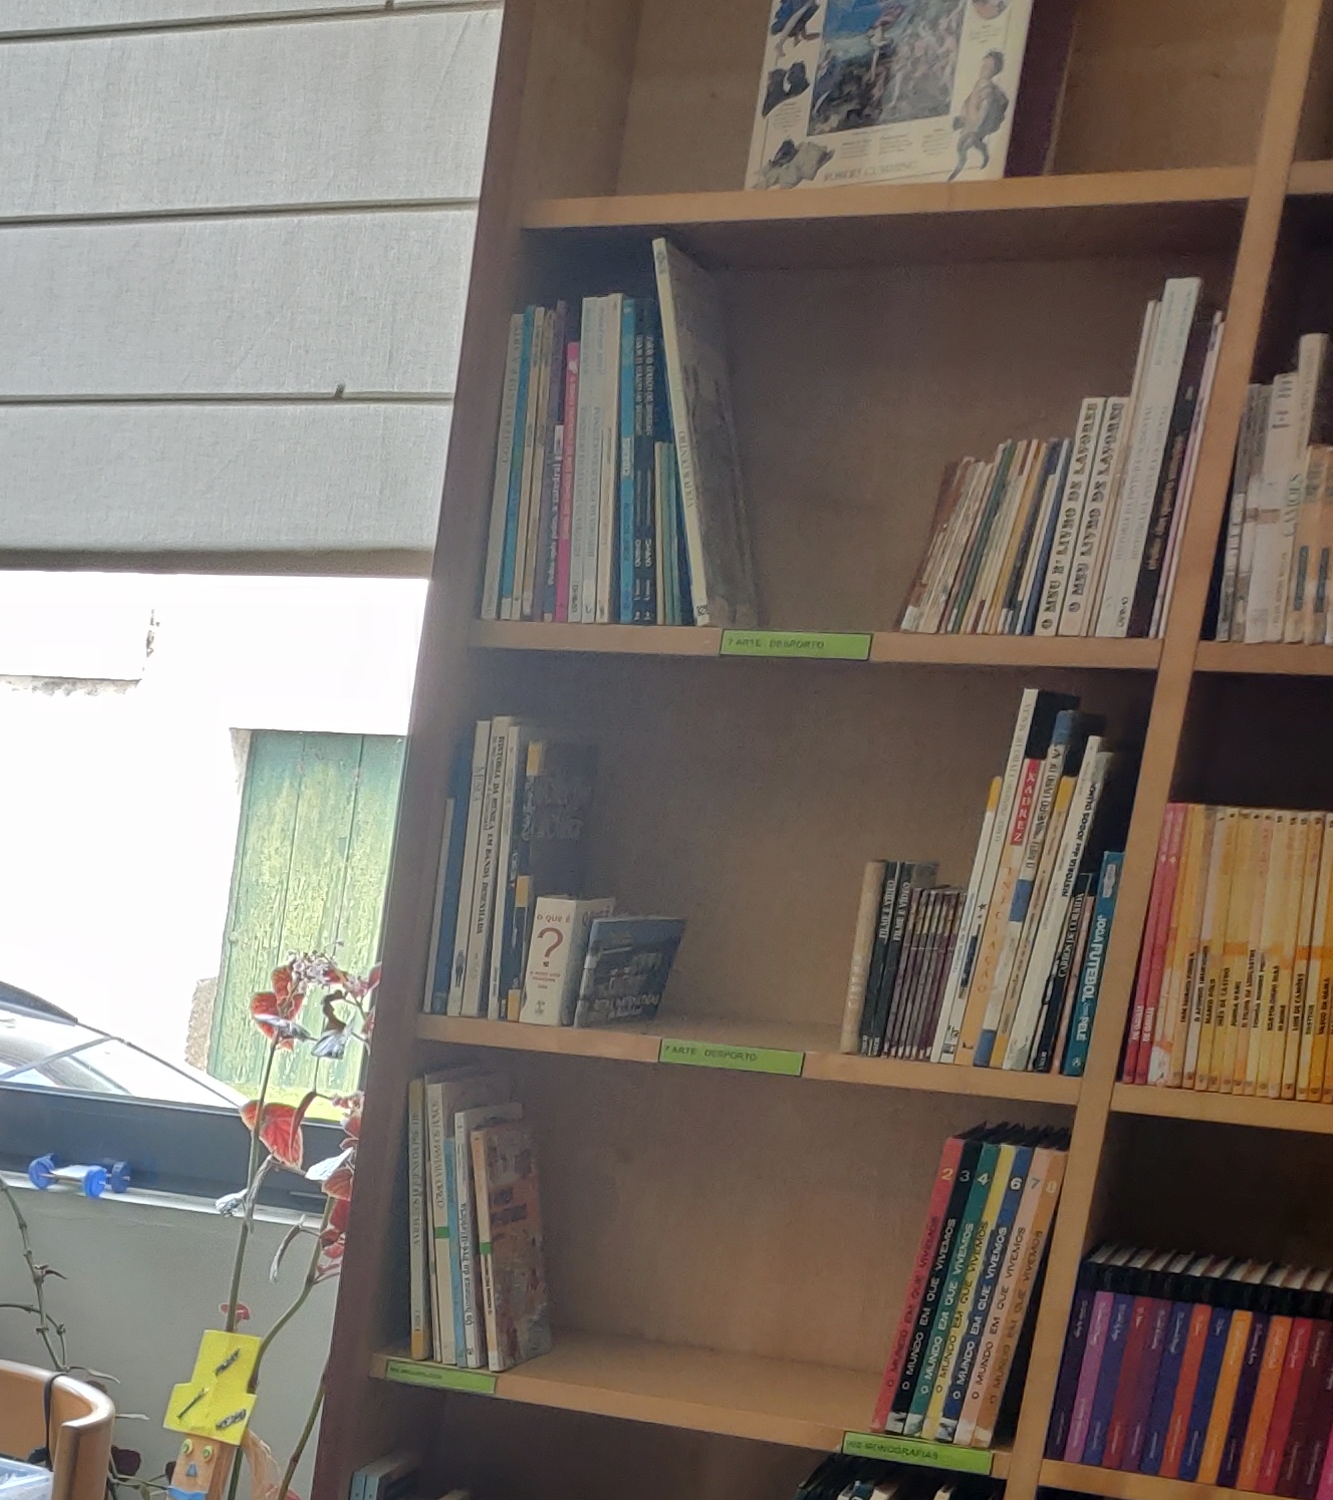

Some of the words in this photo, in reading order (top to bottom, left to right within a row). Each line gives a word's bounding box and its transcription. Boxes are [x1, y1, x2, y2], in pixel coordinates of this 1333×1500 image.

[1071, 401, 1096, 475] LAVORES
[1096, 401, 1123, 476] LAVORES
[1066, 479, 1081, 501] DE
[1091, 479, 1107, 504] DE
[1055, 506, 1076, 556] LIVRO
[1079, 506, 1101, 557] LIVRO
[1071, 561, 1089, 596] MEU
[1044, 579, 1061, 613] MEU
[1068, 600, 1081, 613] O
[1040, 617, 1053, 630] O
[735, 639, 762, 648] ARTE
[769, 640, 826, 650] DESPORTO
[1010, 768, 1038, 843] XADREZ
[481, 847, 493, 879] BANDA
[475, 881, 489, 935] DESENHADA
[1091, 913, 1108, 943] JOGA
[1081, 941, 1103, 1003] FUTEBOL
[1074, 1014, 1091, 1042] PELÉ
[671, 1047, 697, 1055] ARTE
[704, 1050, 758, 1061] DESPORTO
[942, 1165, 953, 1180] 2
[960, 1169, 969, 1181] 3
[978, 1171, 989, 1185] 4
[1012, 1176, 1021, 1190] 6
[1030, 1177, 1039, 1190] 7
[1047, 1180, 1056, 1193] 8
[933, 1217, 957, 1272] VIVEMOS
[952, 1221, 975, 1276] VIVEMOS
[966, 1219, 989, 1274] VIVEMOS
[984, 1225, 1008, 1280] VIVEMOS
[1003, 1225, 1026, 1279] VIVEMOS
[925, 1275, 940, 1302] QUE
[943, 1279, 959, 1306] QUE
[957, 1278, 973, 1305] QUE
[976, 1283, 991, 1311] QUE
[994, 1284, 1009, 1310] QUE
[918, 1305, 932, 1326] EM
[936, 1309, 950, 1331] EM
[951, 1308, 964, 1329] EM
[969, 1314, 983, 1335] EM
[987, 1315, 1001, 1335] EM
[904, 1330, 925, 1376] MUNDO
[923, 1334, 944, 1380] MUNDO
[937, 1333, 958, 1379] MUNDO
[955, 1339, 976, 1385] MUNDO
[973, 1339, 994, 1386] MUNDO
[900, 1379, 911, 1391] O
[919, 1383, 930, 1395] O
[933, 1382, 944, 1393] O
[951, 1388, 962, 1400] O
[969, 1389, 980, 1400] O
[864, 1443, 939, 1460] MONOGRAFIAS
